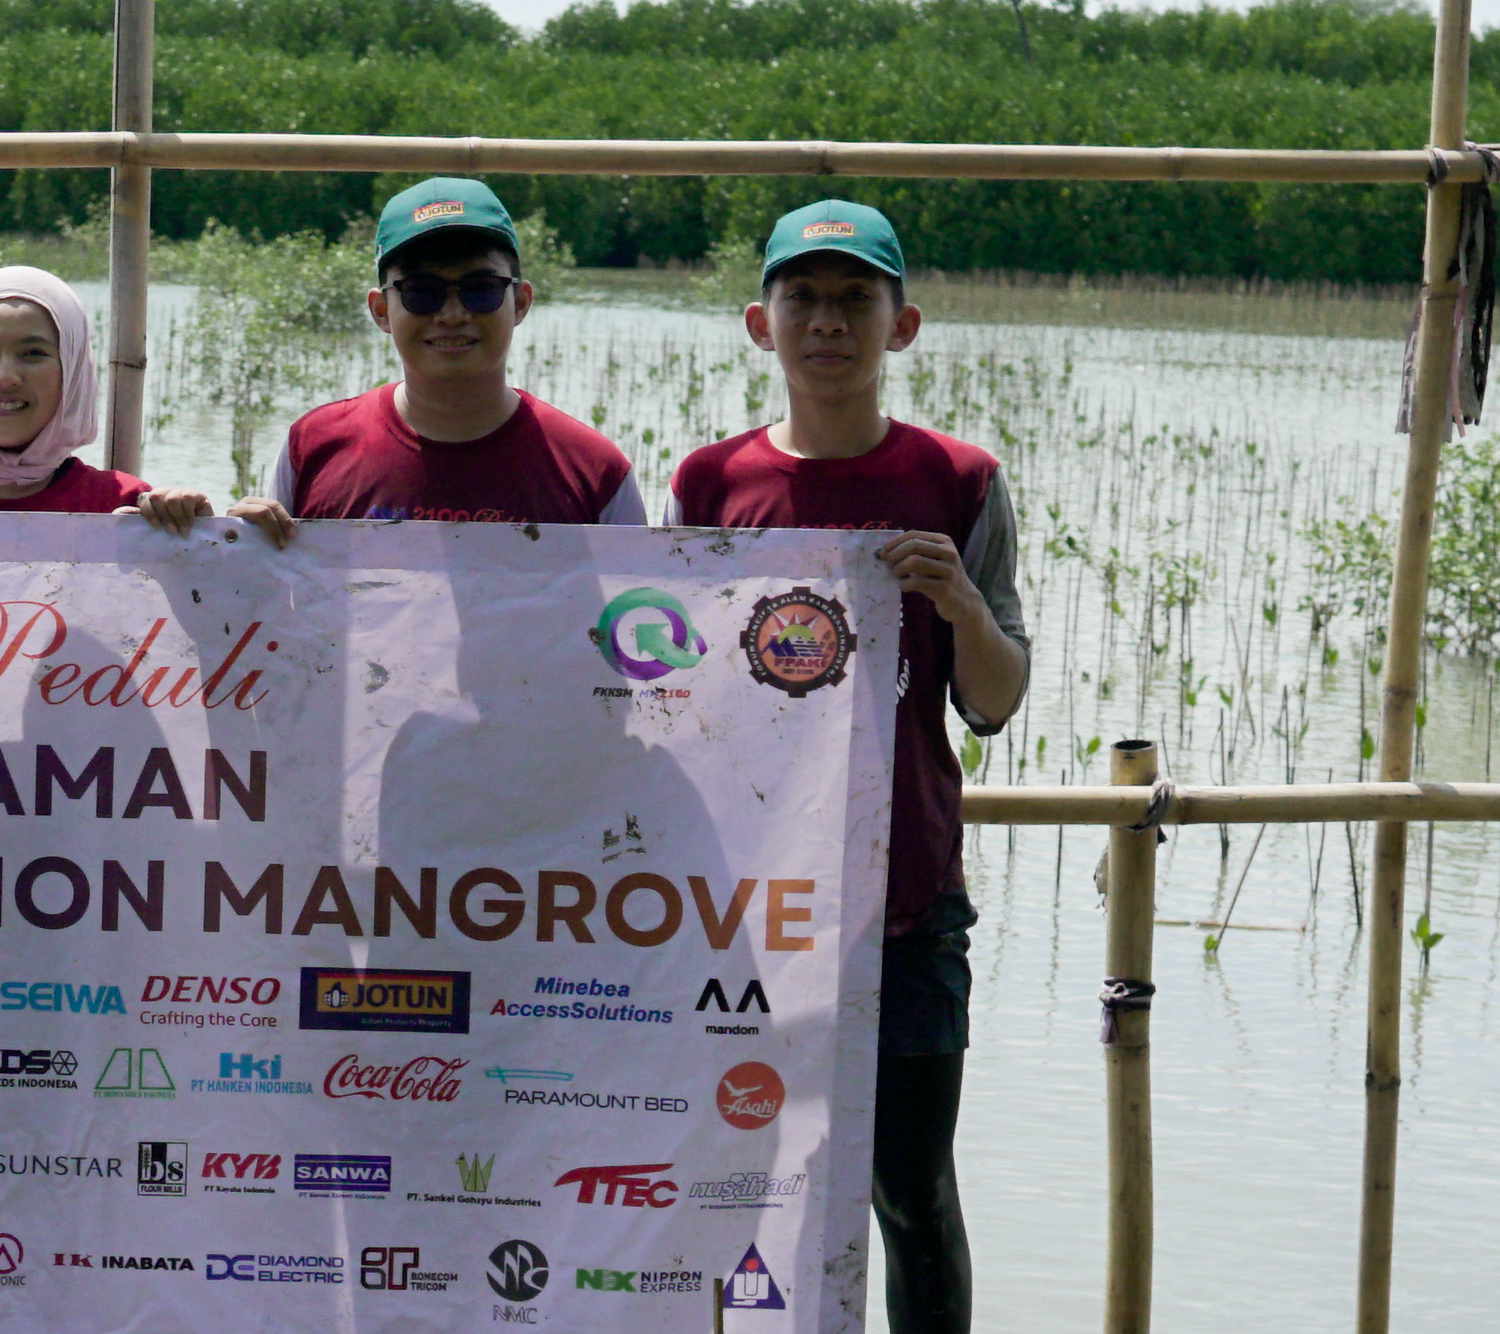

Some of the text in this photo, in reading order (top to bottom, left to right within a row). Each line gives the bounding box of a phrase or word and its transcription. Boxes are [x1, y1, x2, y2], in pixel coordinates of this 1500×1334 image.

[429, 204, 460, 215] JOTUN
[818, 226, 852, 234] JOTUN
[203, 860, 815, 952] MANGROVE
[141, 975, 281, 1005] DENSO
[535, 977, 630, 997] Minebea
[1, 981, 126, 1014] SEIWA
[353, 984, 447, 1008] JOTUN
[140, 1010, 277, 1027] Crafting the Core
[490, 999, 673, 1023] AccessSolutions
[706, 1024, 760, 1036] mandom
[18, 1078, 78, 1089] INDONESIA
[192, 1080, 313, 1094] PT HANKEN INDONESIA
[505, 1090, 688, 1113] PARAMOUNT BED
[722, 1096, 777, 1117] Asahi
[201, 1152, 282, 1179] KYB
[297, 1166, 389, 1181] SANWA
[688, 1172, 806, 1199] nusahadi
[407, 1193, 421, 1201] PT.
[495, 1197, 542, 1207] Industries
[102, 1256, 194, 1271] INABATA
[258, 1255, 344, 1268] DIAMOND
[258, 1270, 344, 1284] ELECTRIC
[411, 1272, 458, 1281] BONECOM
[641, 1271, 702, 1282] NIPPON
[410, 1282, 447, 1291] TRICOM
[640, 1282, 702, 1293] EXPRESS
